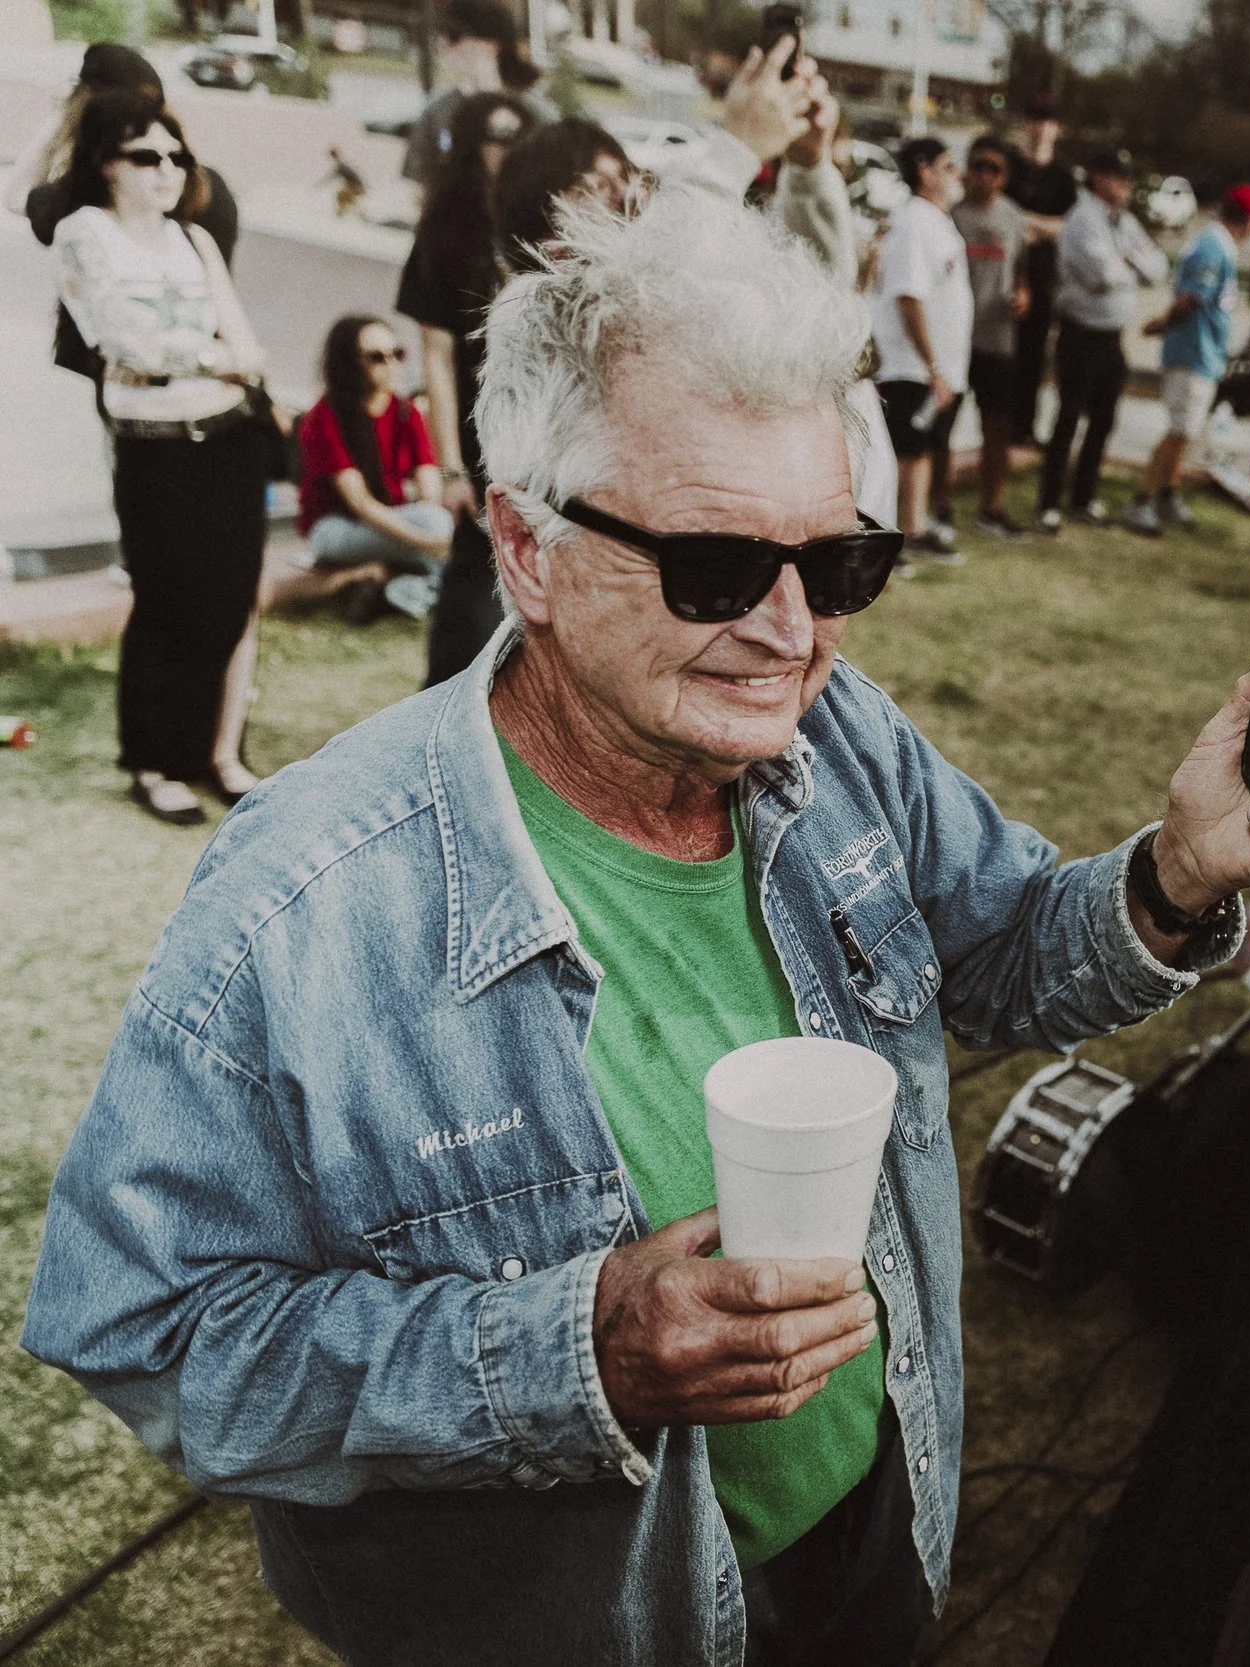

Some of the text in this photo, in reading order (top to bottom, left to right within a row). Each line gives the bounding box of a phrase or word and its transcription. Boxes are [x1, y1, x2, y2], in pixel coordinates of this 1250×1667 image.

[821, 825, 890, 878] FORT WORTH
[416, 1107, 525, 1159] Michael
